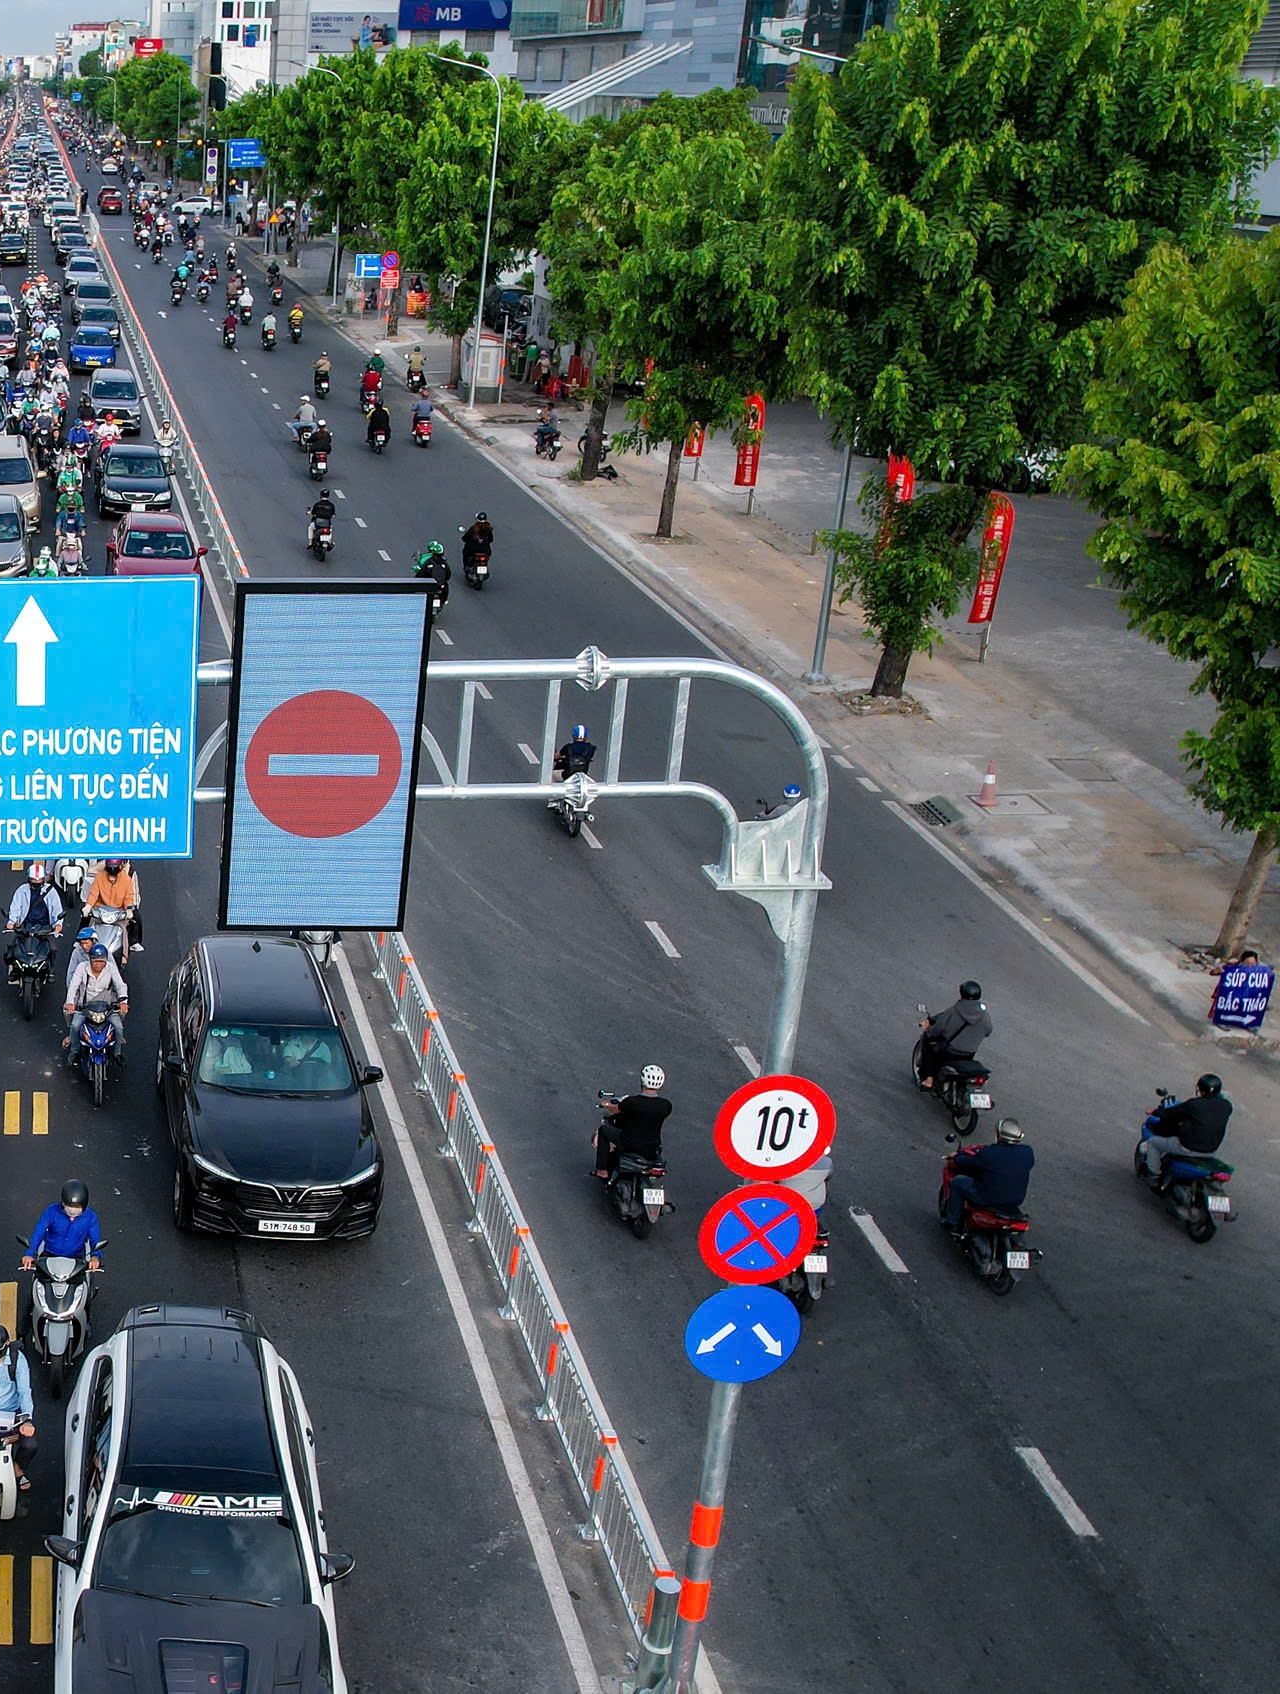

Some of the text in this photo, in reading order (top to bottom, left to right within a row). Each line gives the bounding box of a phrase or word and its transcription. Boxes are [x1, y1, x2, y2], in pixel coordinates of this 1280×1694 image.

[436, 7, 461, 21] MB
[23, 726, 122, 756] PHƯƠNG
[128, 722, 181, 759] TIỆN
[11, 768, 63, 800] LIÊN
[69, 773, 114, 805] TỤC
[120, 762, 169, 799] ĐẾN
[94, 817, 166, 843] CHINH
[1224, 968, 1269, 988] SÚP CUA
[1217, 991, 1267, 1012] BÁC THẢO
[157, 1504, 200, 1515] DRIVING
[193, 1496, 283, 1509] AMG
